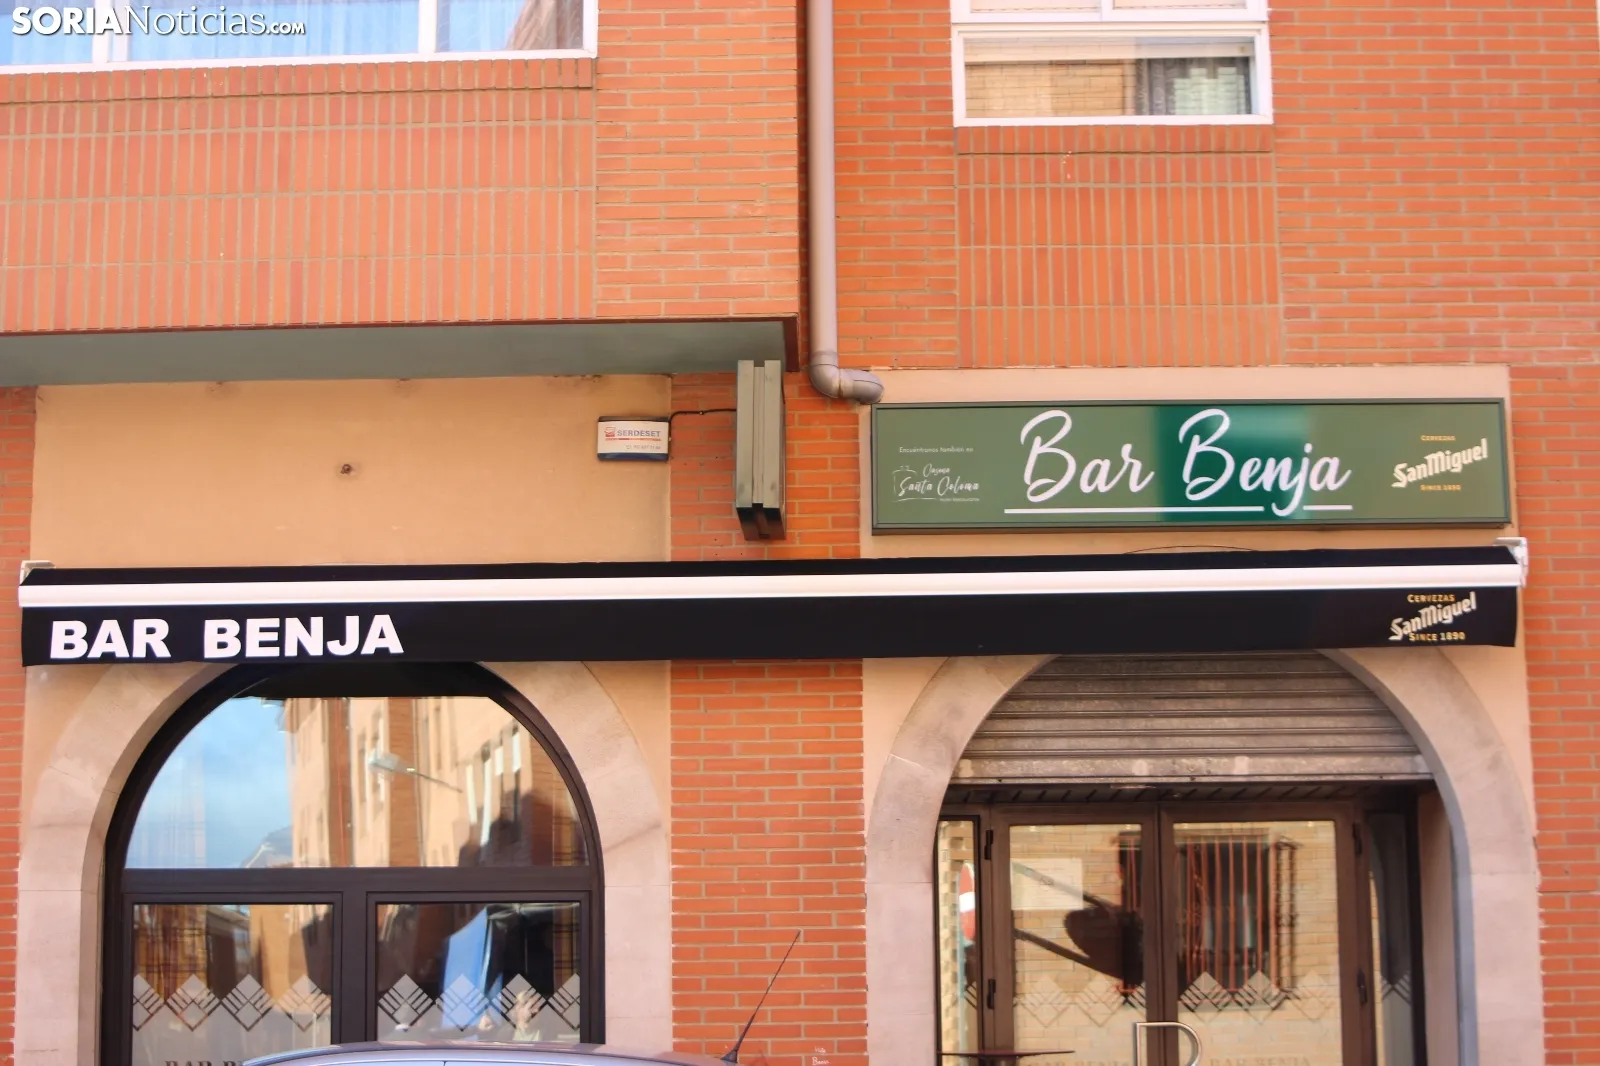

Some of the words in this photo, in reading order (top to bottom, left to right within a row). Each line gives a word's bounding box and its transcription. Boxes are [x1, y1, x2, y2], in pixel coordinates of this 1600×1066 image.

[1020, 409, 1154, 502] Bar
[1178, 408, 1352, 517] Benja
[898, 476, 934, 497] Santa
[1407, 594, 1456, 603] CERVEZAS
[49, 619, 171, 660] BAR
[204, 614, 404, 659] BENJA
[1409, 631, 1438, 642] SINCE
[1440, 631, 1466, 641] 1890
